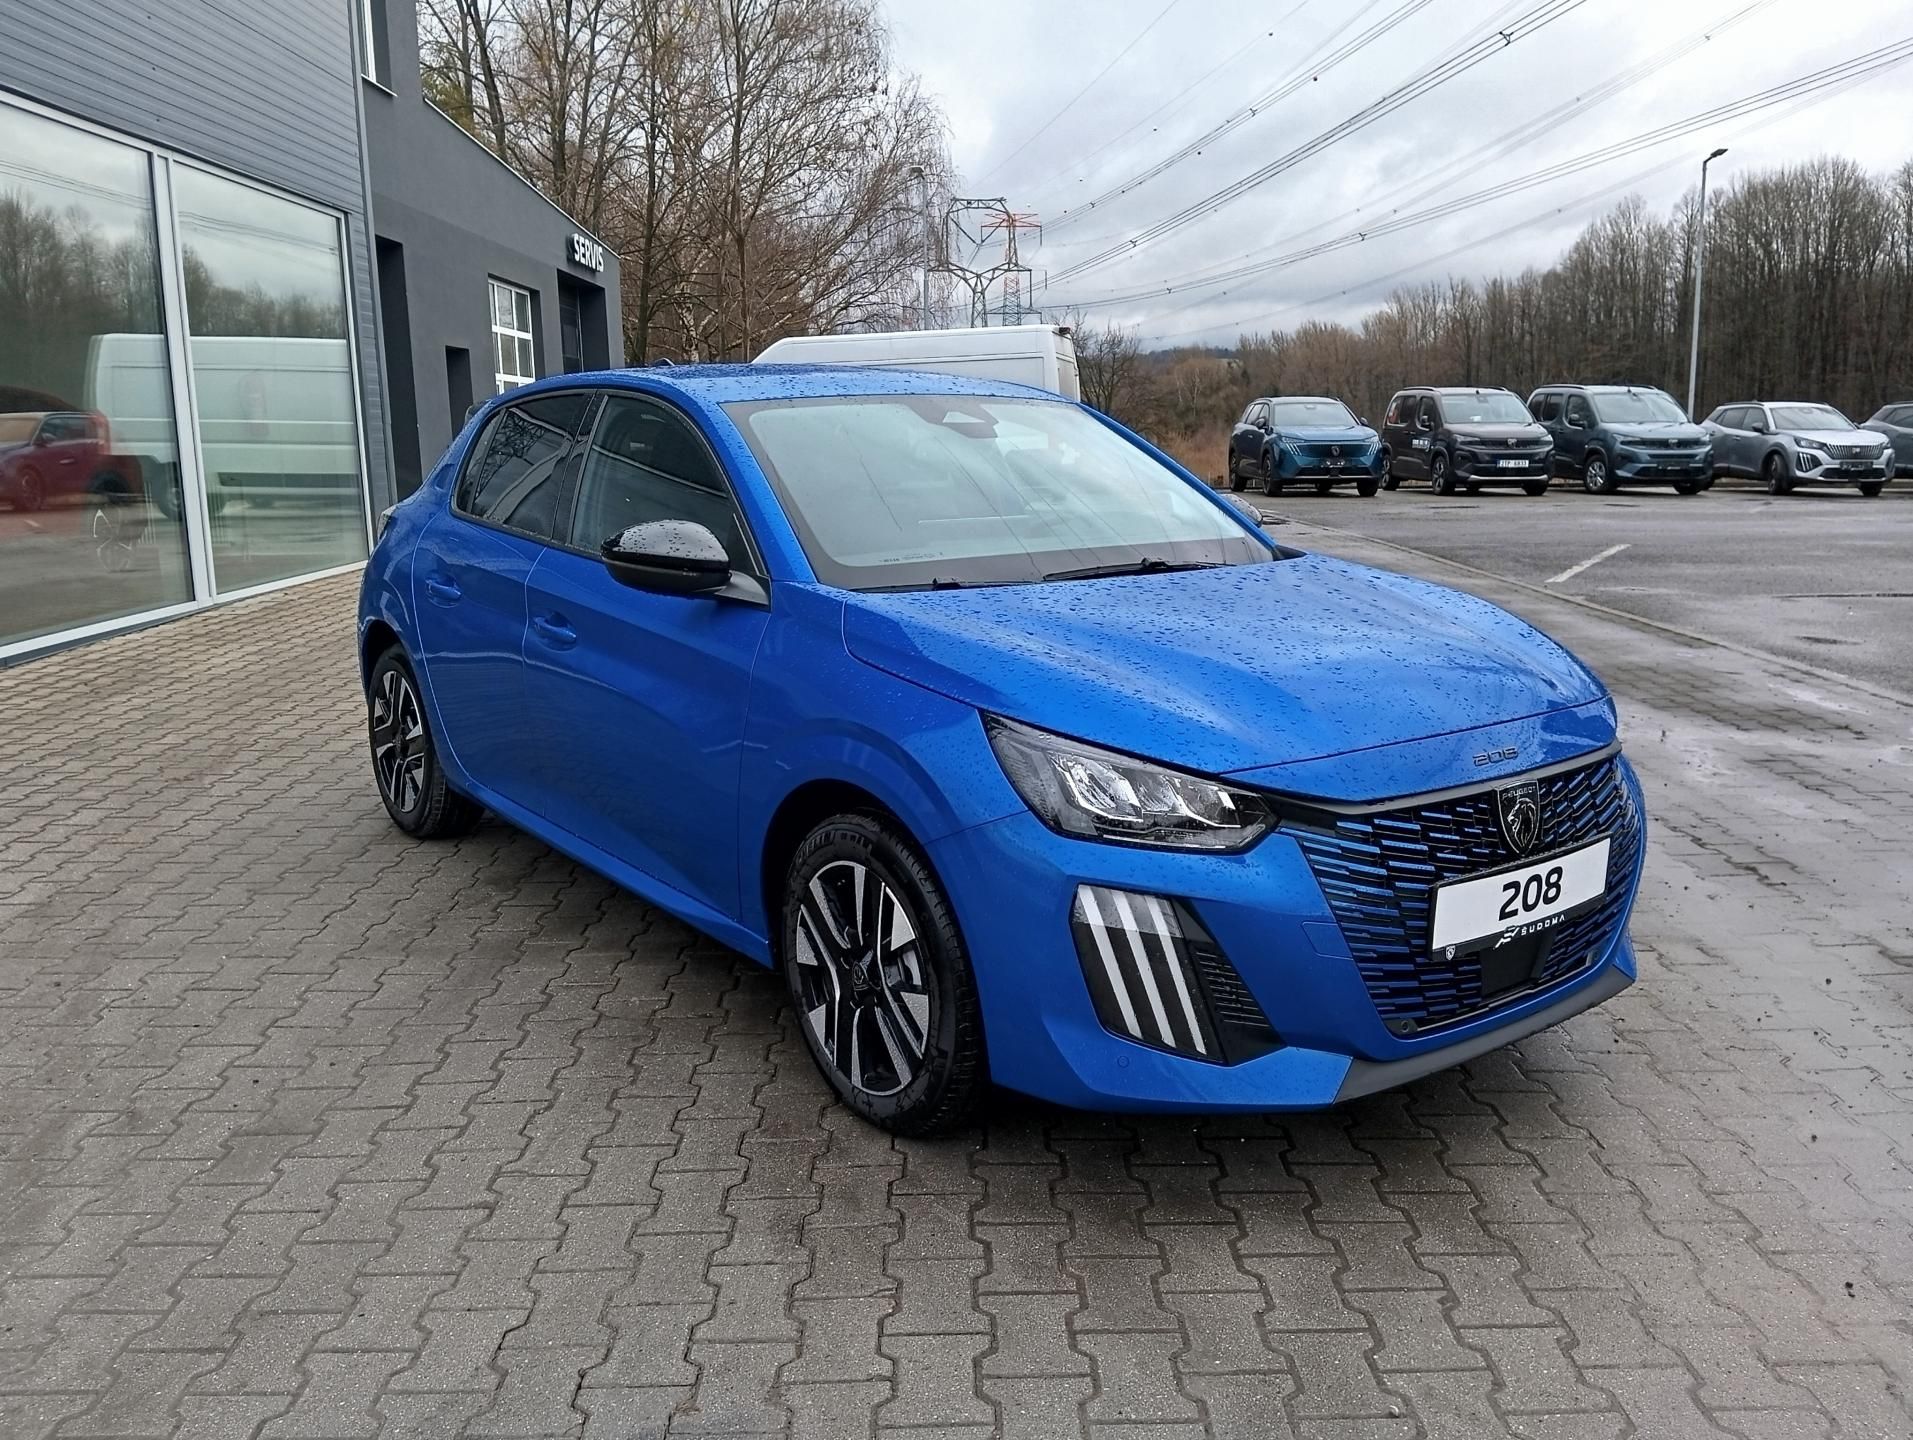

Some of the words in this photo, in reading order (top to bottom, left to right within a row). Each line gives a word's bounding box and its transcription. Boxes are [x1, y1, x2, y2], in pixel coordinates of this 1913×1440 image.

[572, 232, 604, 272] SERVIS
[1473, 747, 1519, 767] 208
[1498, 865, 1564, 922] 208
